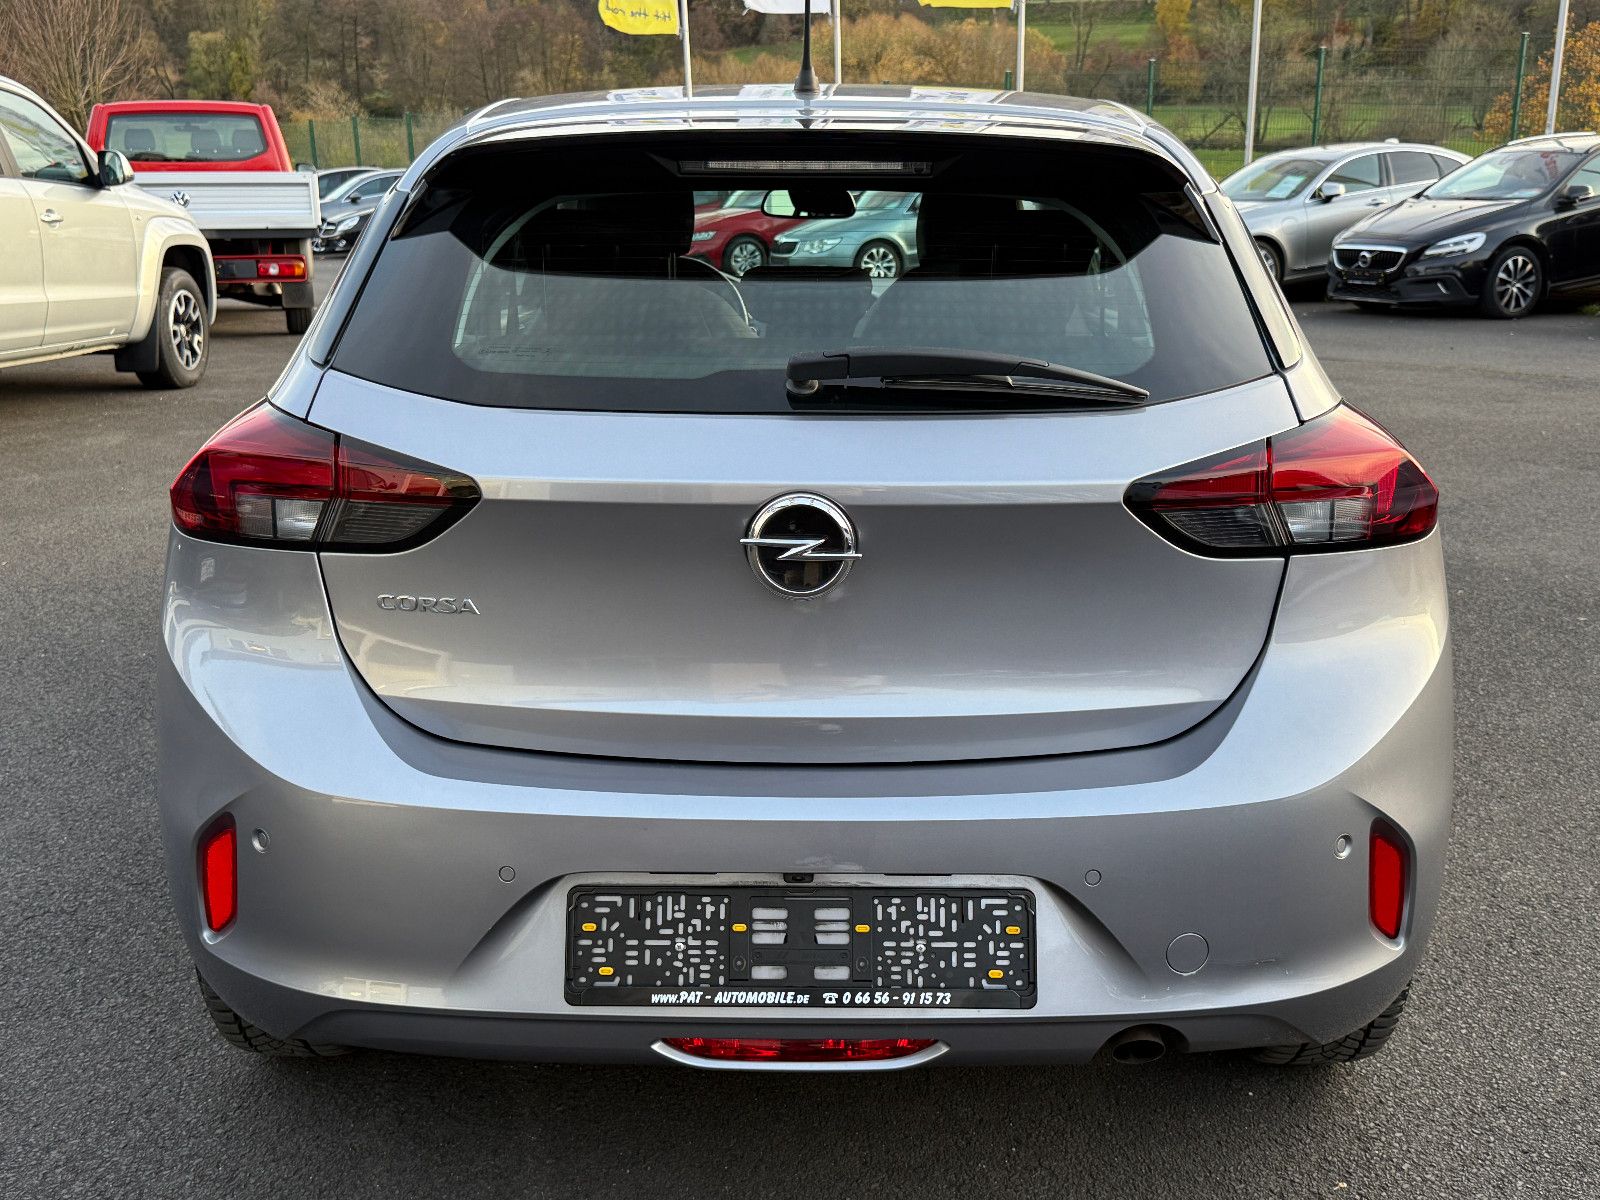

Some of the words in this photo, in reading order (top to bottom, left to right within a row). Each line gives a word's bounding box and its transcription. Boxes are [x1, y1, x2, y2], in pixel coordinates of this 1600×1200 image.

[377, 594, 480, 615] CORSA
[651, 991, 703, 1004] www.PAT
[713, 991, 810, 1004] AUTOMOBILE.DE
[842, 992, 851, 1004] 0
[854, 992, 871, 1004] 66
[873, 992, 890, 1004] 56
[902, 992, 916, 1005] 91
[919, 992, 933, 1004] 15
[935, 992, 951, 1004] 73
